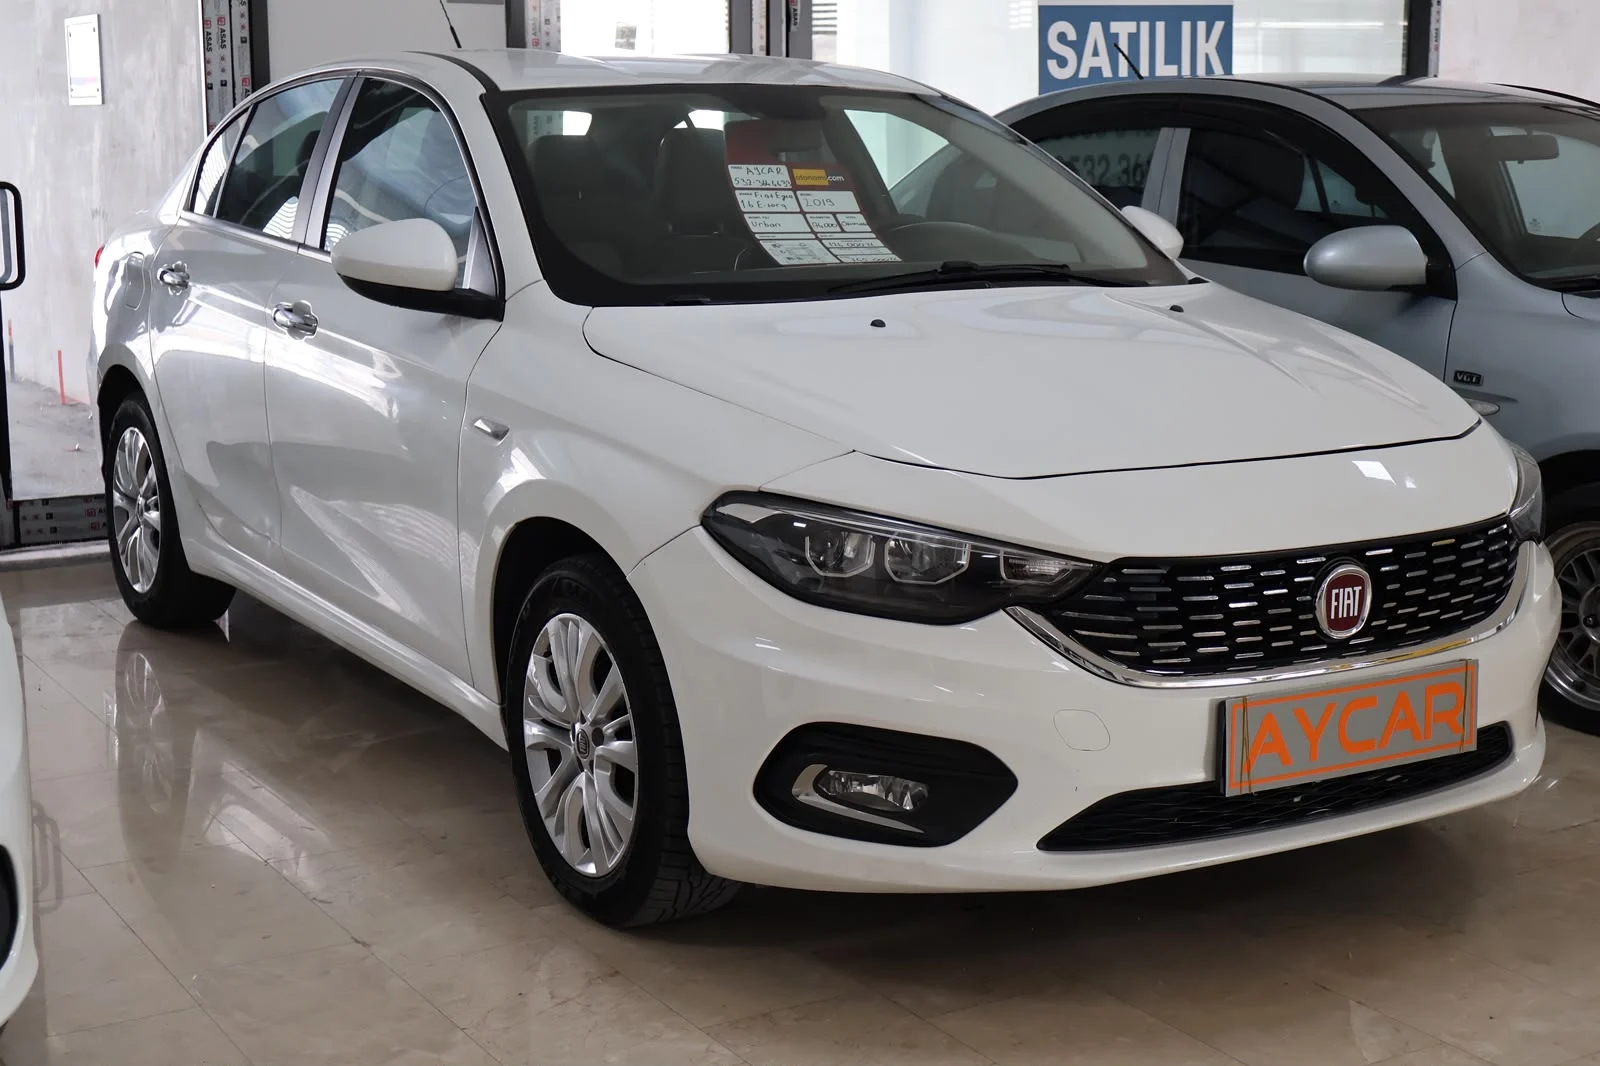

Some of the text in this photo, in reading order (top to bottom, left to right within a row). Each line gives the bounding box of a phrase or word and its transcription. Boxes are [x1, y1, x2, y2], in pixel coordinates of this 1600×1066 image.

[205, 31, 213, 52] ASAS
[1047, 20, 1225, 79] SATILIK
[746, 166, 783, 176] AYCAR
[803, 197, 836, 207] 2019
[751, 220, 781, 228] Urban
[1330, 585, 1362, 620] FIAT
[1243, 681, 1465, 775] AYCAR
